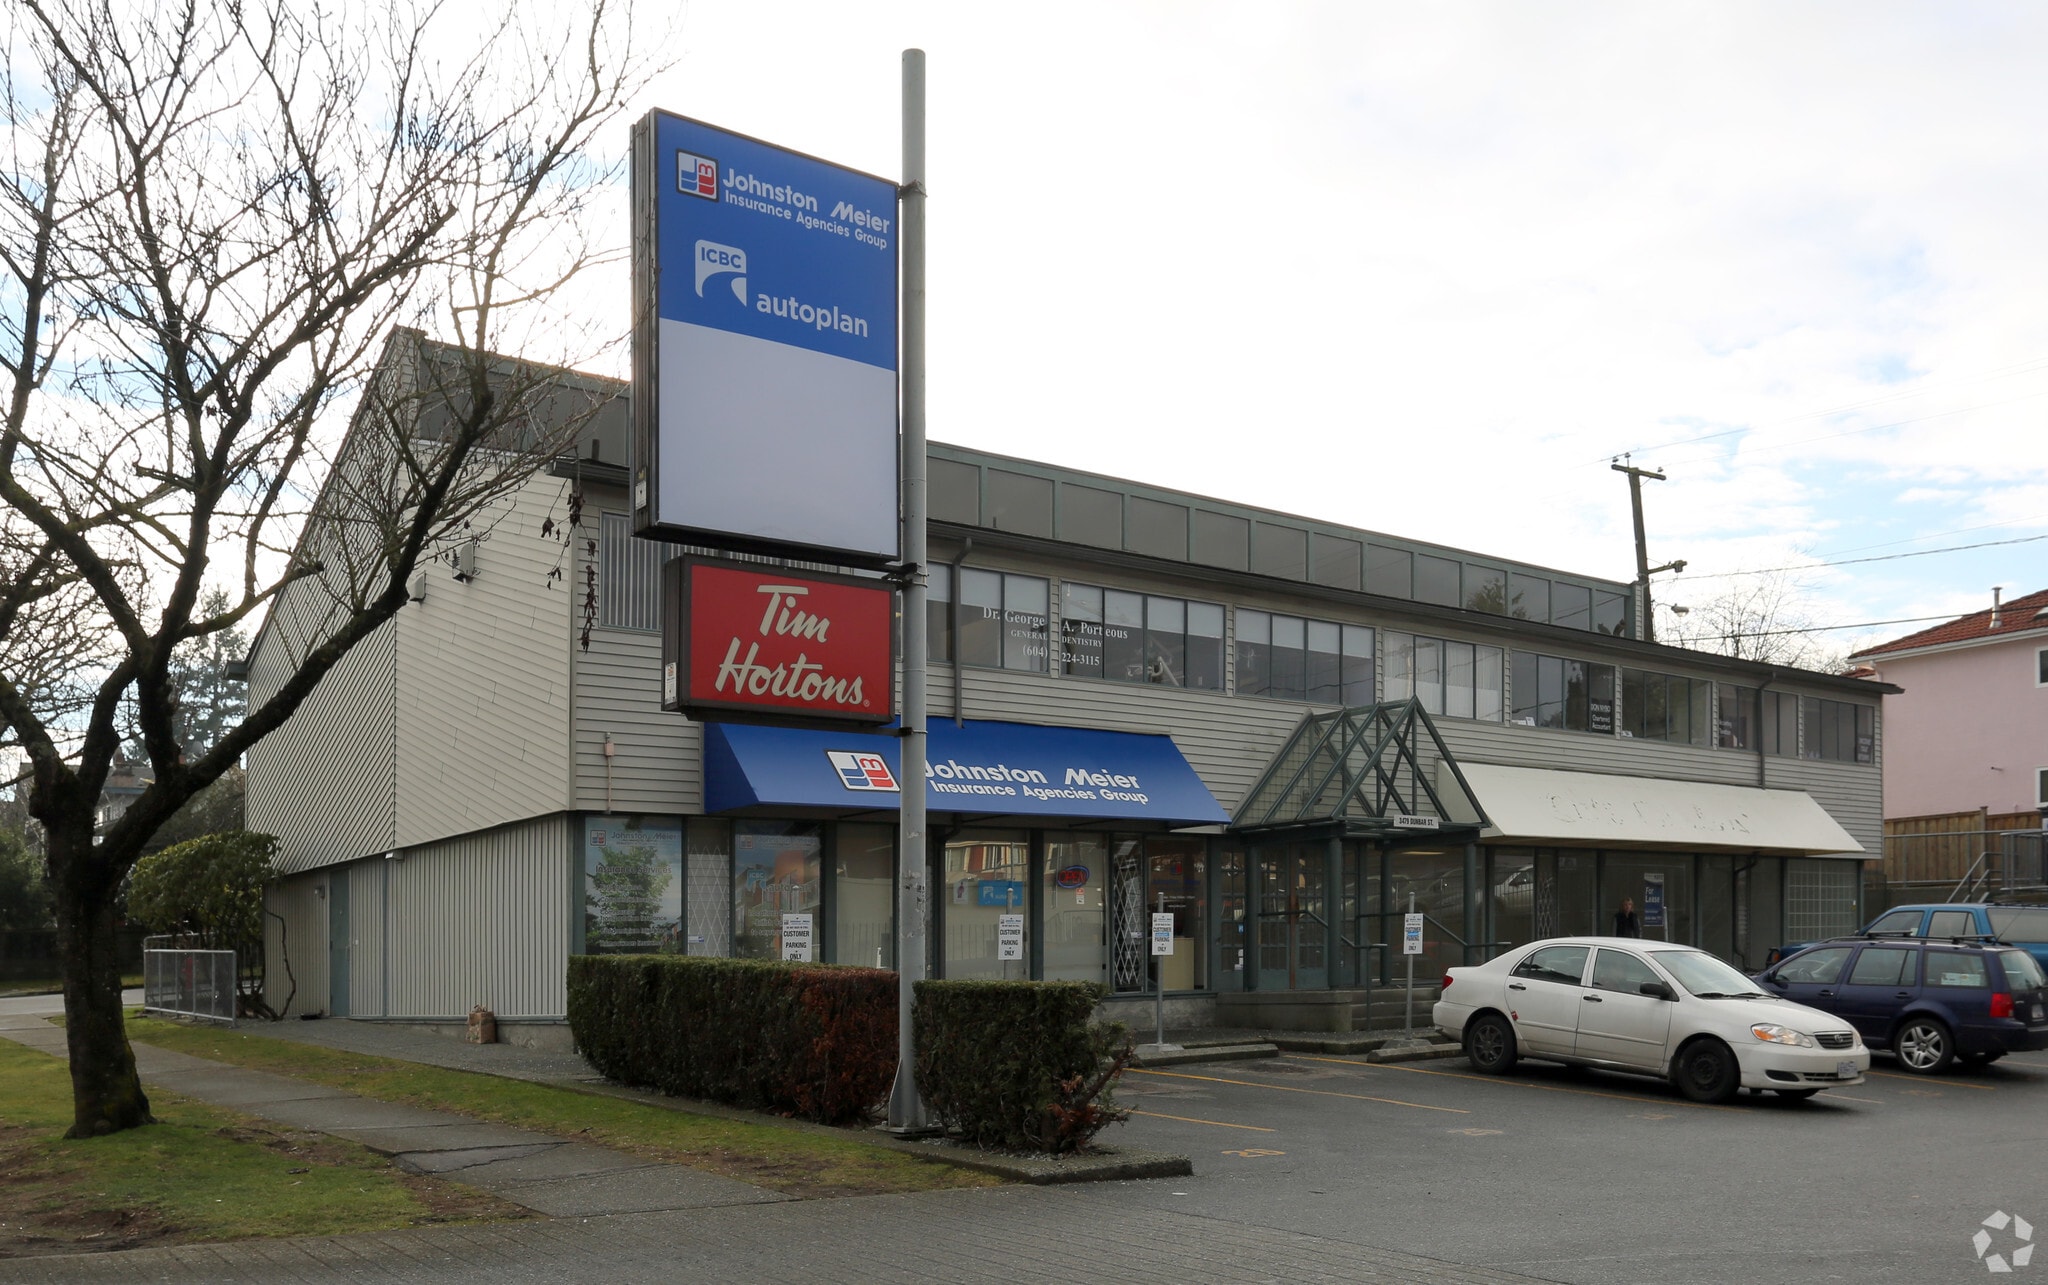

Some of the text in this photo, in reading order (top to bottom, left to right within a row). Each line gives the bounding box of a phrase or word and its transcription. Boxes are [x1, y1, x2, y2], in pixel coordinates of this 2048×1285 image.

[722, 168, 890, 234] Johnston Meier
[725, 190, 888, 250] Insurance Agencies Group
[701, 246, 742, 269] ICBC
[756, 293, 868, 338] autoplan
[756, 584, 830, 643] Tim
[983, 607, 1000, 620] Dr.
[1004, 610, 1045, 629] George
[1062, 620, 1074, 632] A.
[1010, 630, 1103, 648] GENERAL DENTISTRY
[1022, 644, 1100, 666] (604) 224-3115
[714, 636, 863, 705] Hortons
[925, 759, 1141, 789] Johnston Meier
[930, 780, 1149, 805] Insurance Agencies Group
[1059, 870, 1087, 884] OPEN
[785, 941, 807, 949] PARKING
